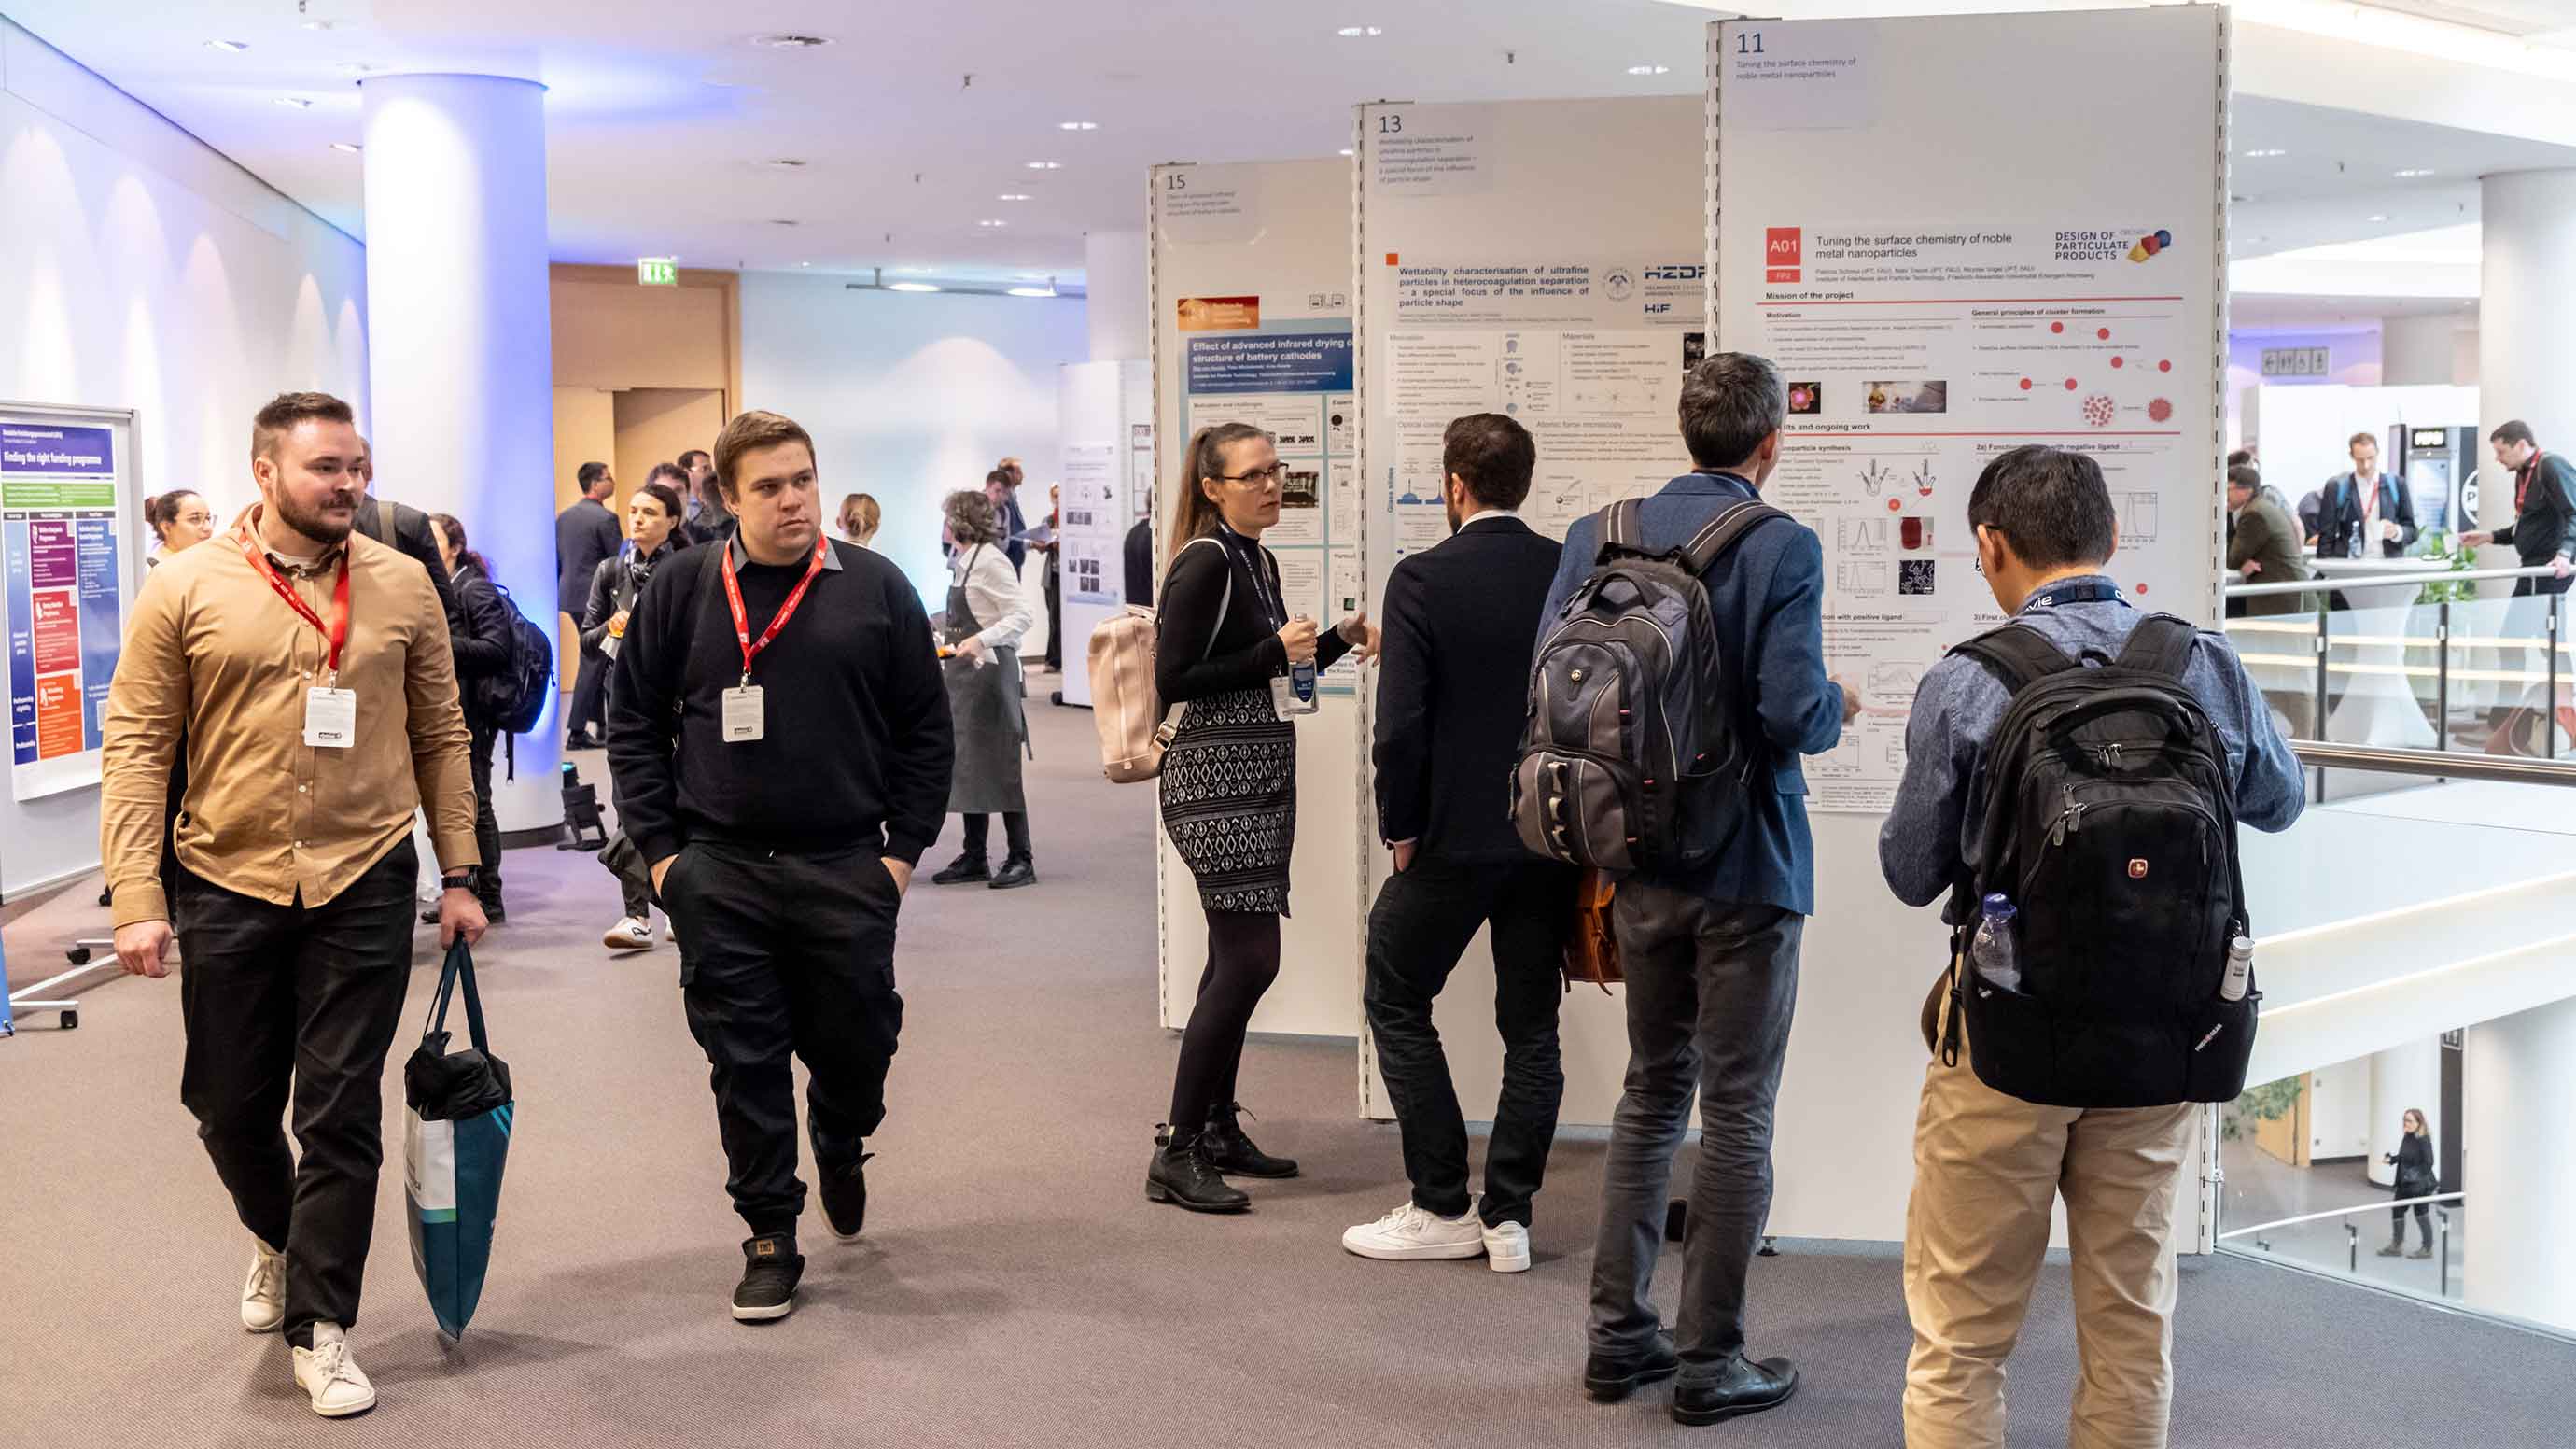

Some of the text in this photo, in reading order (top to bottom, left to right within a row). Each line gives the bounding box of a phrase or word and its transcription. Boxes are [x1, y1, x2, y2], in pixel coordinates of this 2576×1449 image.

[1737, 33, 1764, 53] 11
[1808, 59, 1846, 68] chemistry
[1848, 57, 1856, 65] of
[1379, 115, 1402, 133] 13
[1167, 174, 1186, 190] 15
[1817, 233, 2012, 248] Tuning the surface chemistry of noble
[2055, 232, 2115, 241] DESIGN OF
[1770, 239, 1798, 253] A01
[2055, 241, 2129, 250] PARTICULATE
[1816, 247, 1918, 260] metal nanoparticles
[2055, 251, 2117, 260] PRODUCTS
[1399, 268, 1448, 276] Wettability
[1399, 278, 1438, 288] particles
[1453, 277, 1536, 287] heterocoagulation
[1539, 277, 1589, 287] separation
[1423, 288, 1455, 298] special
[1462, 288, 1487, 296] focus
[1493, 288, 1504, 296] of
[1509, 288, 1523, 296] the
[1531, 288, 1572, 296] influence
[1579, 287, 1589, 295] of
[1766, 290, 1854, 302] Mission of the project
[1399, 299, 1463, 308] particle shape
[1645, 303, 1671, 313] HiF
[2000, 309, 2035, 317] principles
[1193, 343, 1220, 351] Effect
[1221, 342, 1231, 351] of
[1232, 341, 1275, 350] advanced
[1278, 340, 1312, 349] infrared
[1315, 339, 1345, 349] drying
[1193, 352, 1322, 363] structure of battery cathodes
[1815, 423, 1849, 432] ongoing
[1852, 422, 1870, 430] work
[1819, 445, 1851, 454] synthesis
[2066, 443, 2095, 452] negative
[2098, 443, 2120, 451] ligand
[4, 451, 102, 467] Finding the right funding programme
[1853, 613, 1880, 622] positive
[1882, 613, 1903, 622] ligand
[1981, 612, 1998, 621] First
